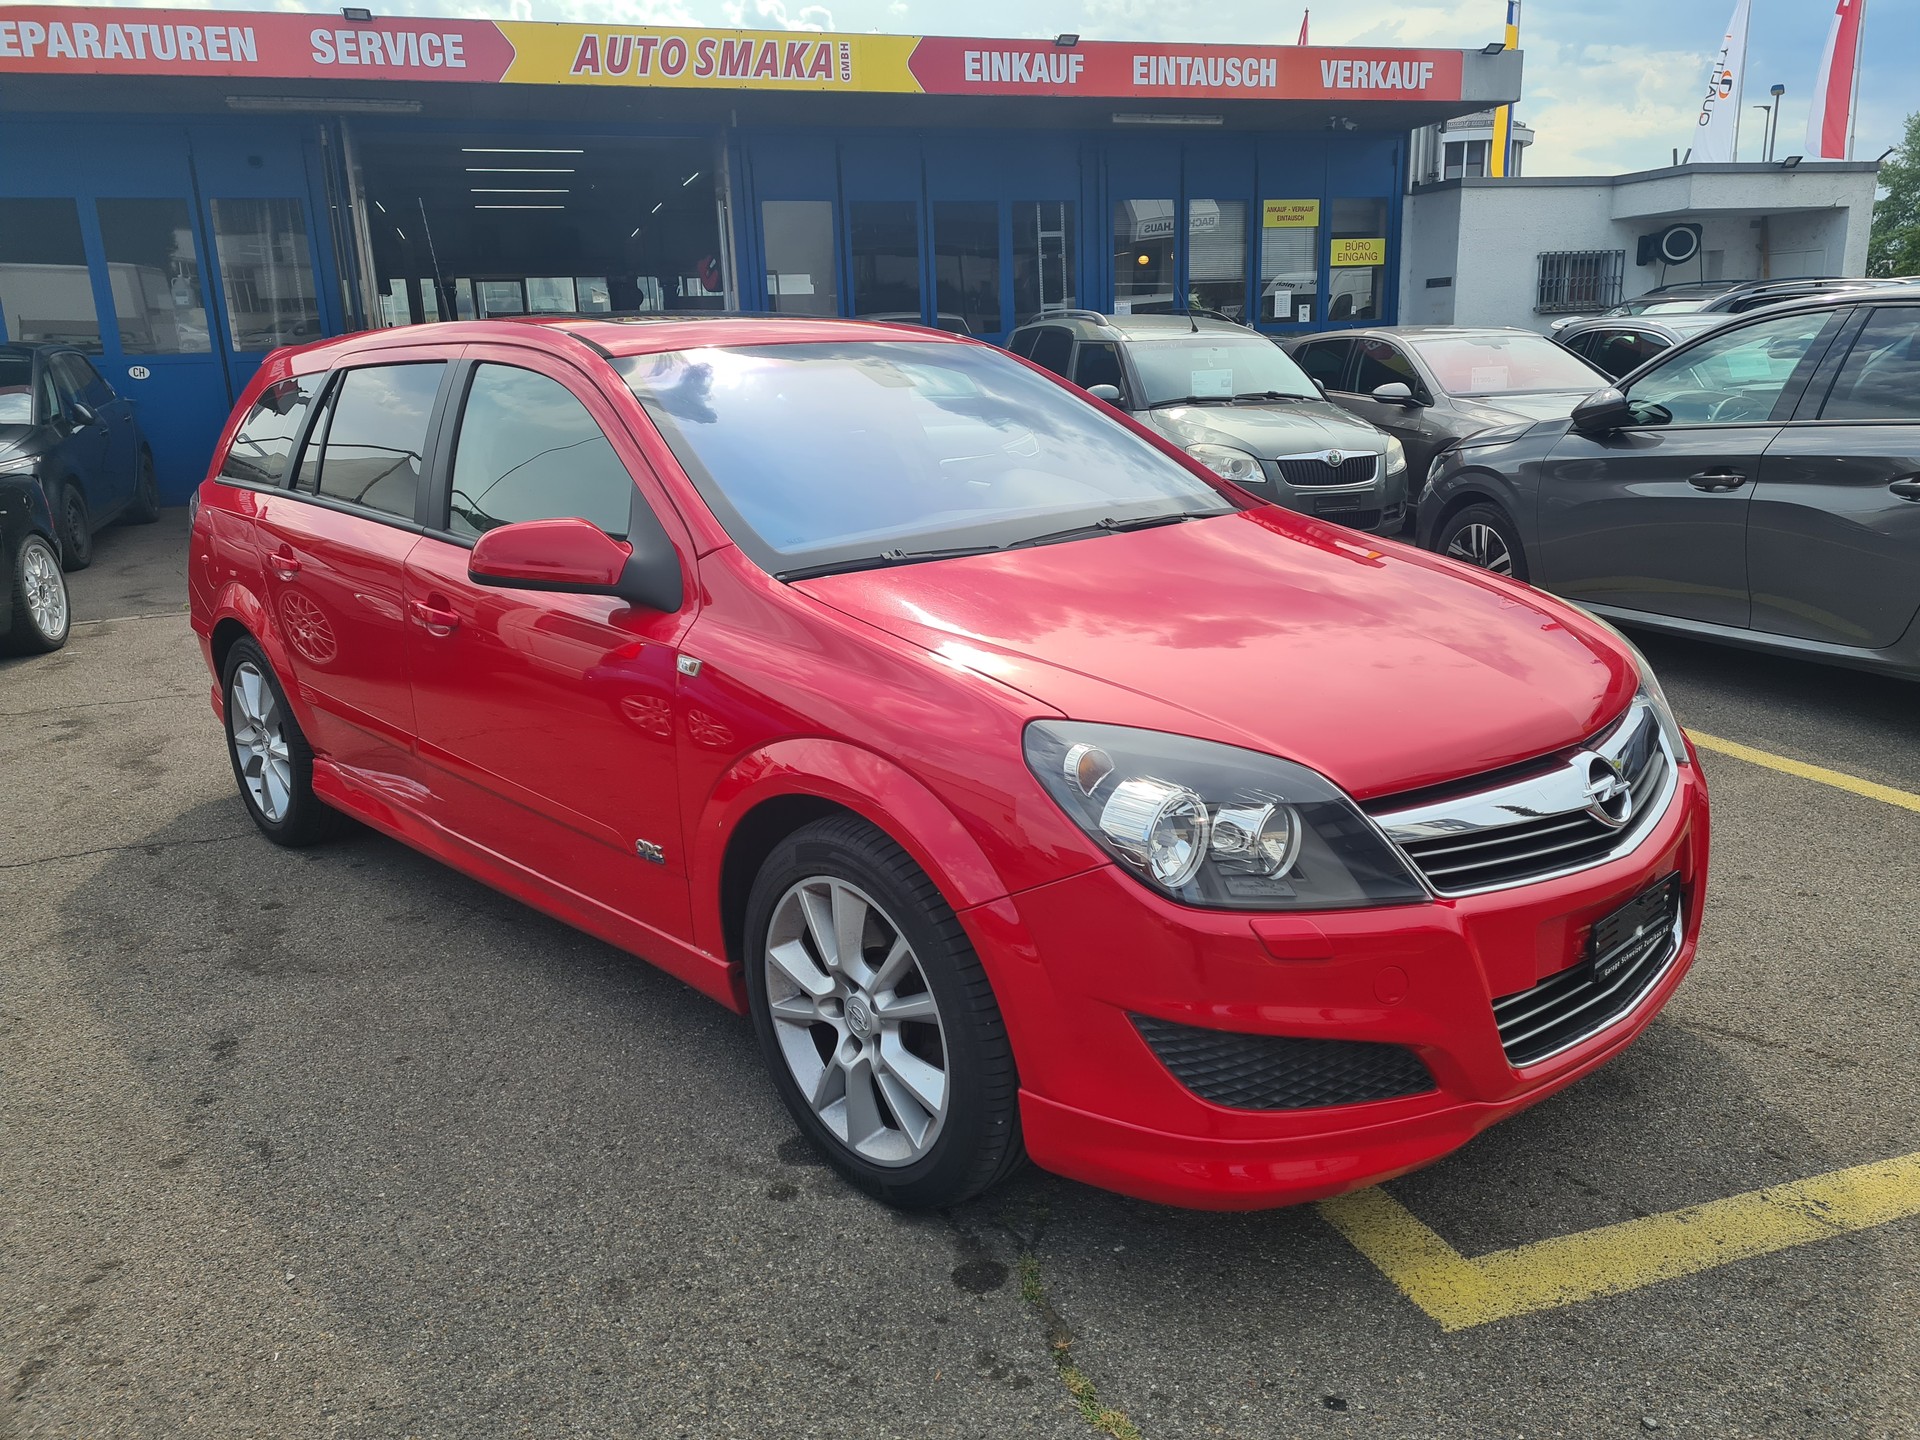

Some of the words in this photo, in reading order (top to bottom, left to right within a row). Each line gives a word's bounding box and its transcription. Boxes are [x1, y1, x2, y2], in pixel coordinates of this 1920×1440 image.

[310, 28, 467, 68] SERVICE
[570, 34, 688, 78] AUTO
[693, 38, 835, 81] SMAKA
[840, 41, 851, 82] GMBH
[964, 51, 1085, 83] EINKAUF
[1133, 55, 1278, 87] EINTAUSCH
[1320, 59, 1435, 89] VERKAUF
[1337, 252, 1378, 261] EINGANG
[1345, 241, 1371, 251] BÜRO
[133, 367, 145, 377] CH
